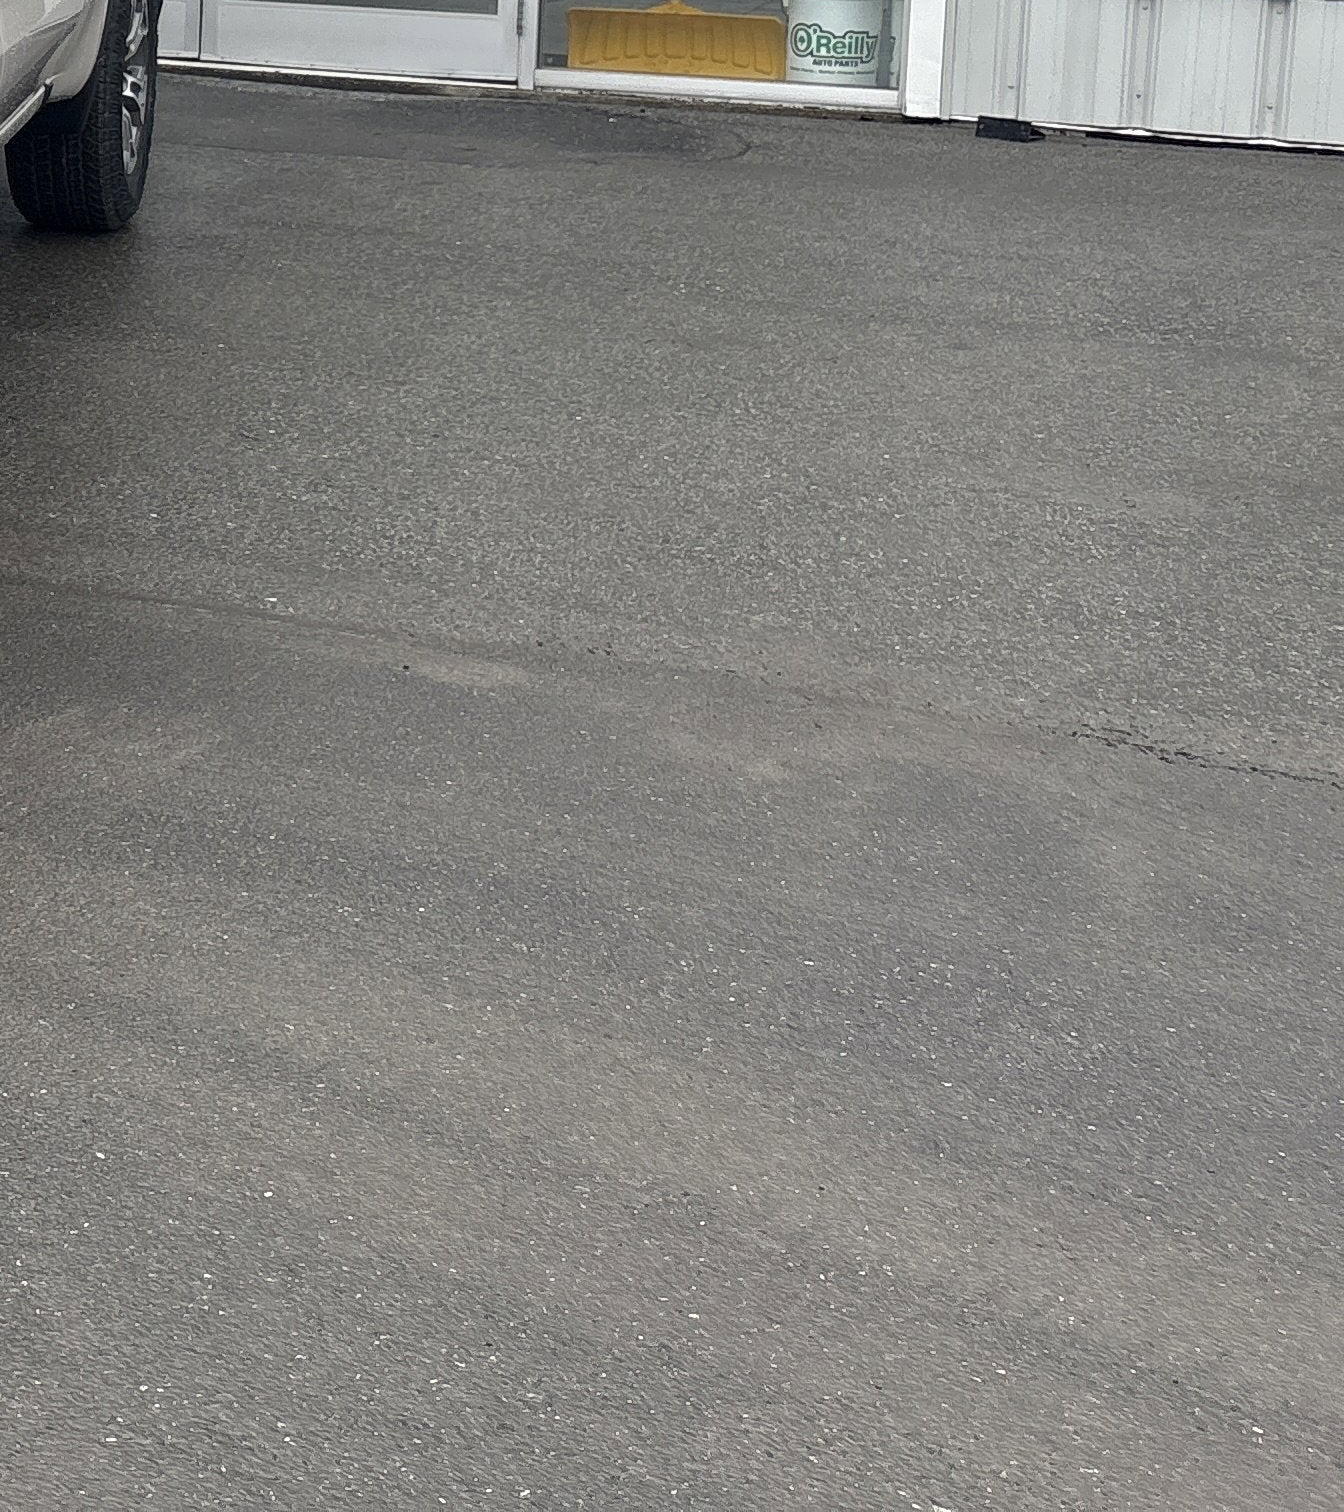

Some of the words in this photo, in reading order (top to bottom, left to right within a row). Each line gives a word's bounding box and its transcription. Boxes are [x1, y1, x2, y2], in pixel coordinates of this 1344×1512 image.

[792, 25, 878, 61] O'Reilly
[812, 58, 833, 66] AUTO
[834, 59, 859, 68] PARTS
